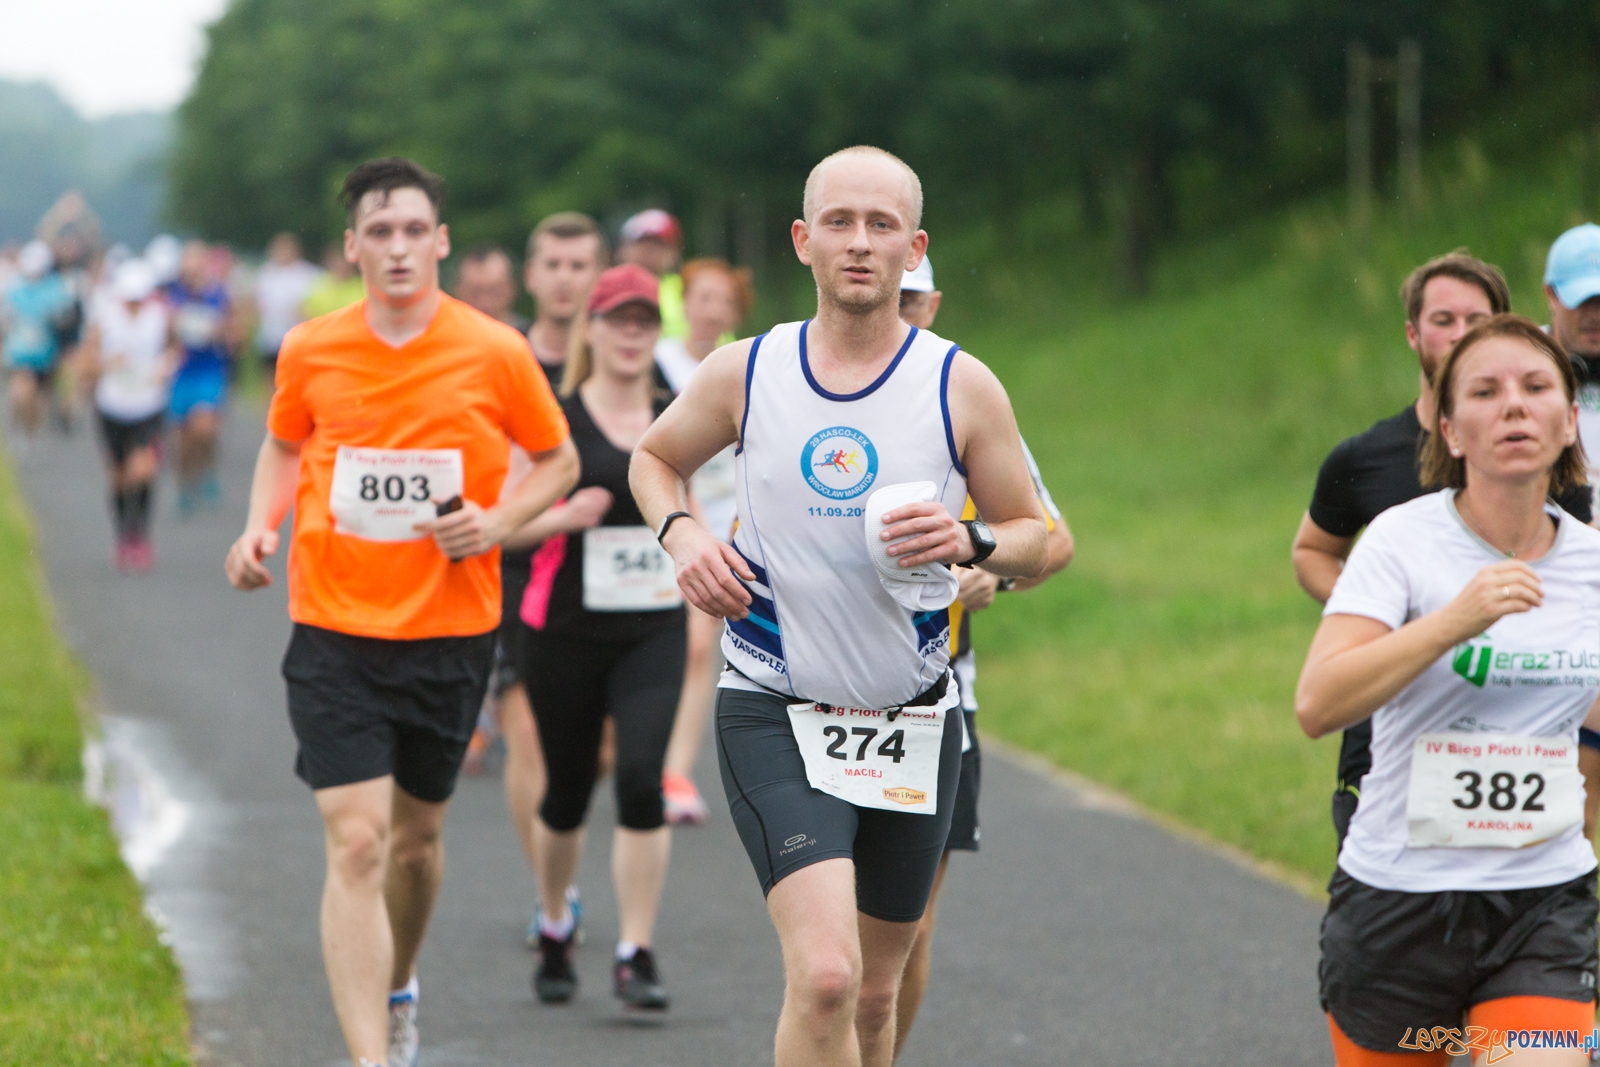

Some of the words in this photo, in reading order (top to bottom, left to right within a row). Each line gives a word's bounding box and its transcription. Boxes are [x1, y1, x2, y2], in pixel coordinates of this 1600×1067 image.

[360, 475, 430, 501] 803
[845, 471, 875, 497] MARATON
[808, 506, 866, 517] 11.09.20
[823, 725, 905, 763] 274
[1426, 742, 1443, 754] IV
[1447, 742, 1482, 758] Bieg
[1488, 743, 1522, 756] Piotr
[844, 767, 883, 779] MACIEJ
[884, 790, 900, 798] Piotr
[1451, 770, 1545, 812] 382
[1467, 820, 1534, 831] KAROLINA
